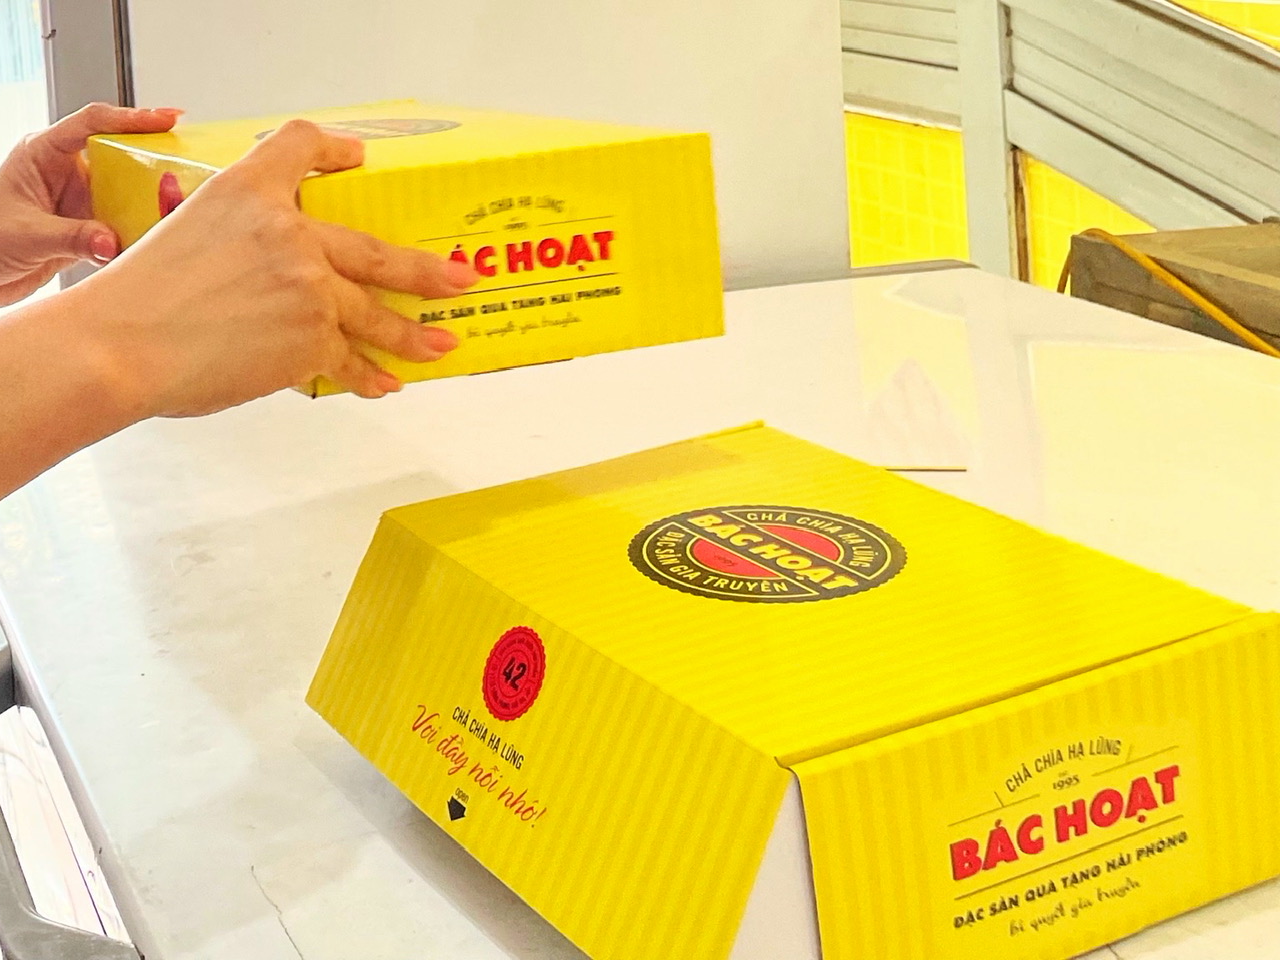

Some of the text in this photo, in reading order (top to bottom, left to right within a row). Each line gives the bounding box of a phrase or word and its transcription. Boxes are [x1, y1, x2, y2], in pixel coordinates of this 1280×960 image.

[505, 230, 615, 273] HOẠT
[687, 514, 859, 590] BÁC HOẠT
[669, 565, 701, 580] GIA
[502, 656, 528, 692] 42
[1052, 774, 1081, 790] 1995
[949, 764, 1181, 881] BÁC HOẠT
